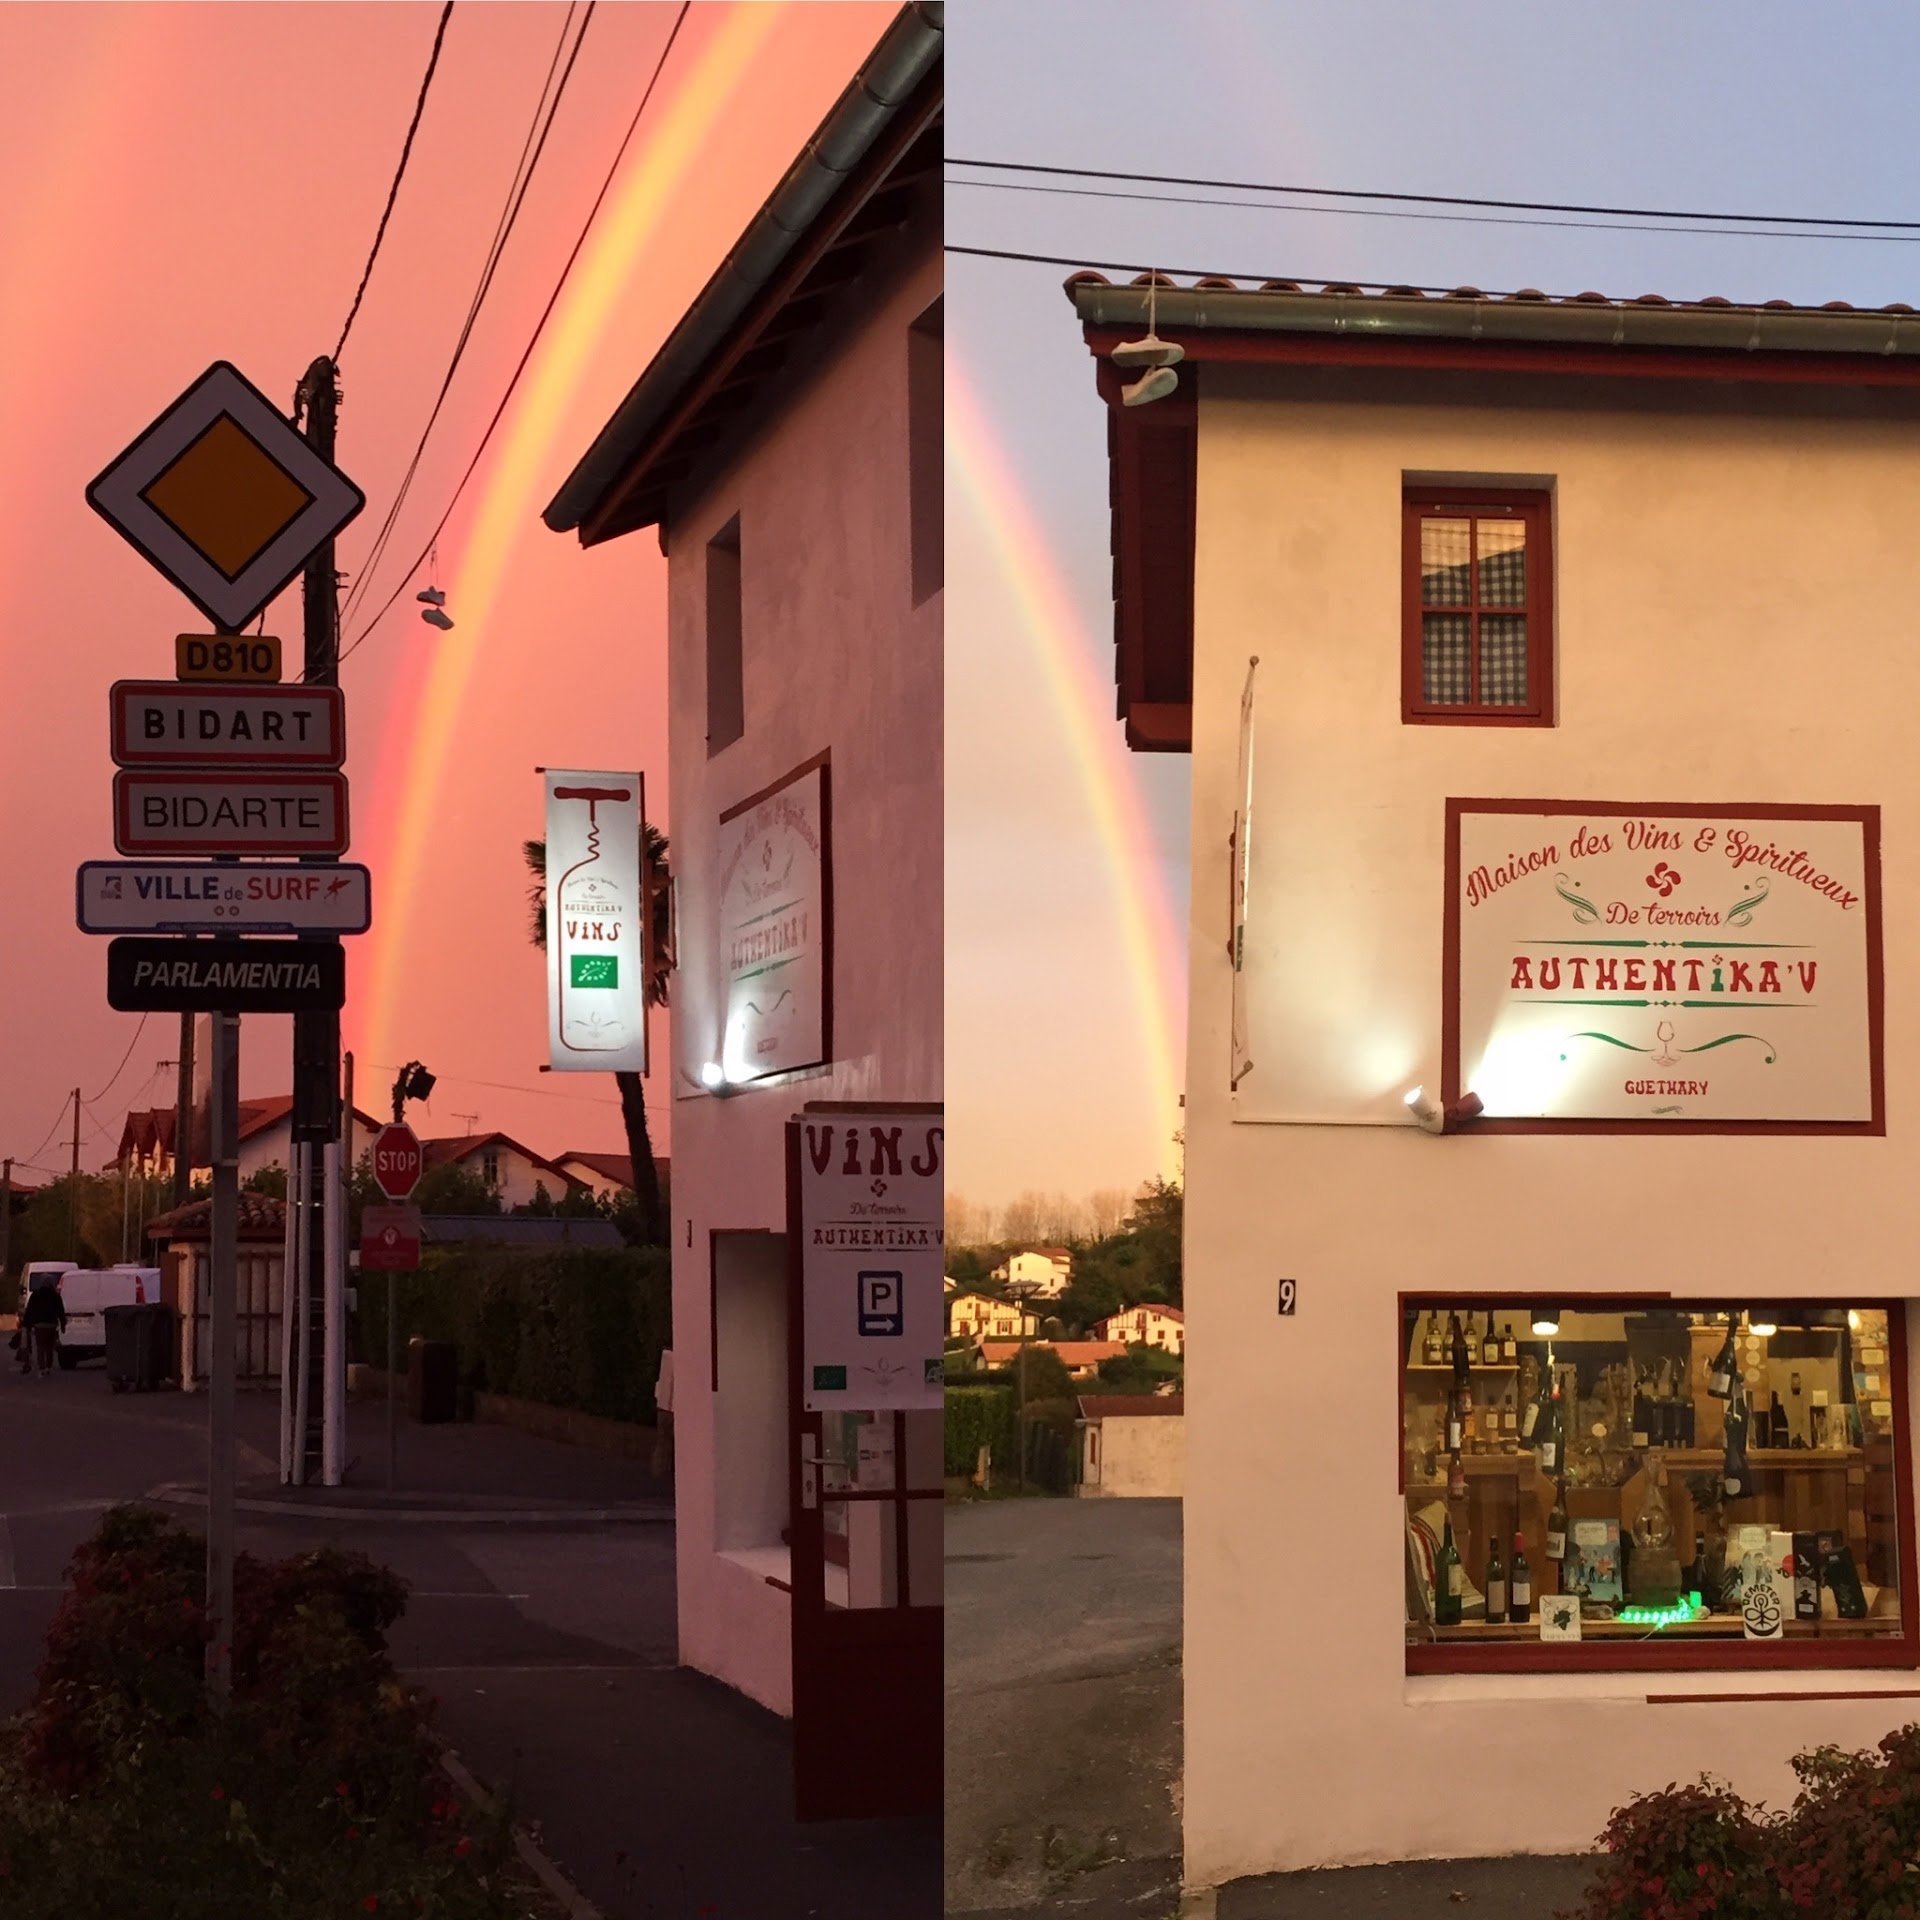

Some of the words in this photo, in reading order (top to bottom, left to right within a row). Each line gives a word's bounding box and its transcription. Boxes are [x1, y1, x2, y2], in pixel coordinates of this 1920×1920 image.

[187, 641, 273, 674] D810
[143, 708, 313, 741] BIDART
[142, 796, 321, 829] BIDARTE
[1465, 844, 1561, 907] Maison
[1569, 825, 1613, 860] des
[1622, 820, 1684, 852] Vins
[1693, 827, 1717, 852] &
[1724, 828, 1860, 911] Spiritueux
[134, 876, 220, 900] VILLE
[224, 886, 243, 901] de
[247, 876, 321, 901] SURF
[1606, 902, 1641, 926] De
[1646, 902, 1723, 927] terroirs
[133, 960, 321, 990] PARLAMENTIA
[1624, 1079, 1709, 1096] GUETHARY
[378, 1151, 417, 1171] STOP
[871, 1283, 892, 1311] P
[1280, 1280, 1295, 1312] 9
[1742, 1583, 1780, 1606] DEMETER
